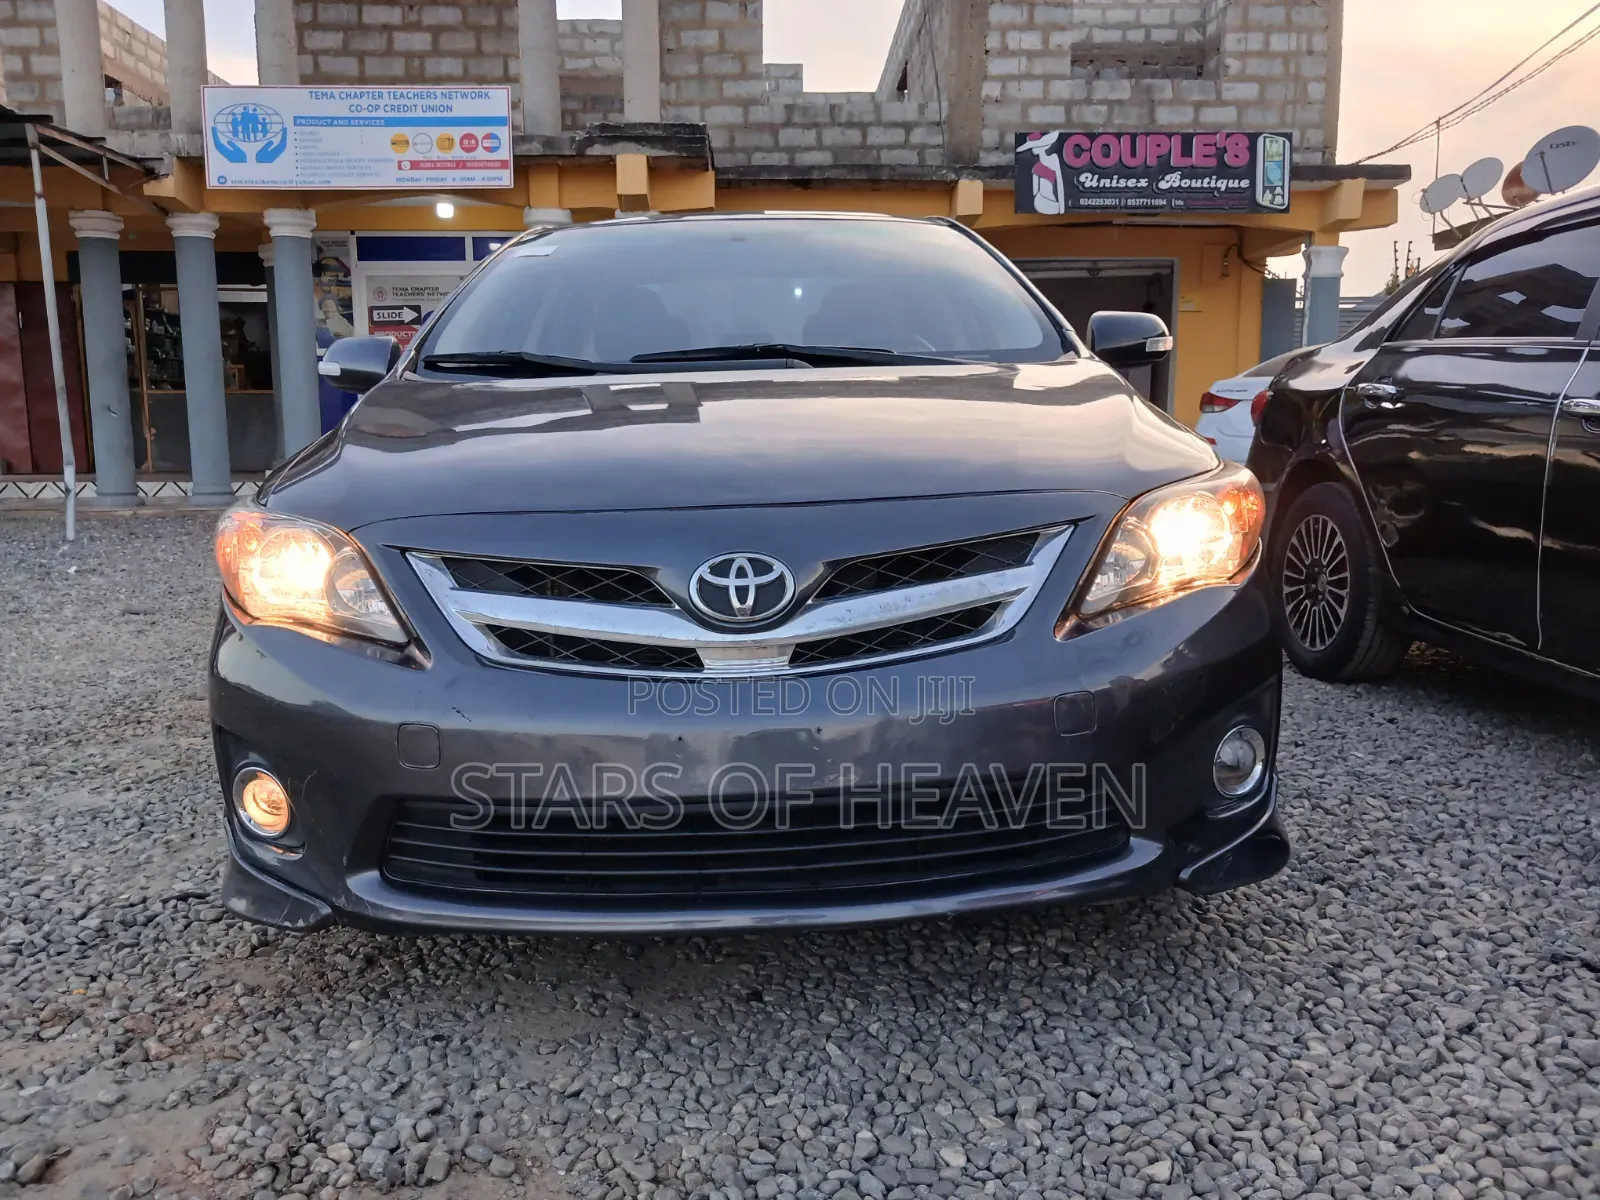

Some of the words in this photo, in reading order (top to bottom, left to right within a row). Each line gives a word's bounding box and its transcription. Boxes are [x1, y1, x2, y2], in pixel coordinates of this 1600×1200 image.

[309, 90, 336, 100] TEMA
[339, 90, 384, 100] CHAPTER
[387, 90, 438, 100] TEACHERS
[440, 90, 491, 100] NETWORK
[349, 104, 380, 113] CO-OP
[383, 104, 418, 113] CREDIT
[421, 104, 453, 113] UNION
[296, 118, 332, 126] PRODUCT
[1063, 131, 1250, 168] COUPLE'S
[1077, 172, 1149, 189] Unisex
[1155, 171, 1250, 192] Boutique
[376, 311, 404, 319] SLIDE
